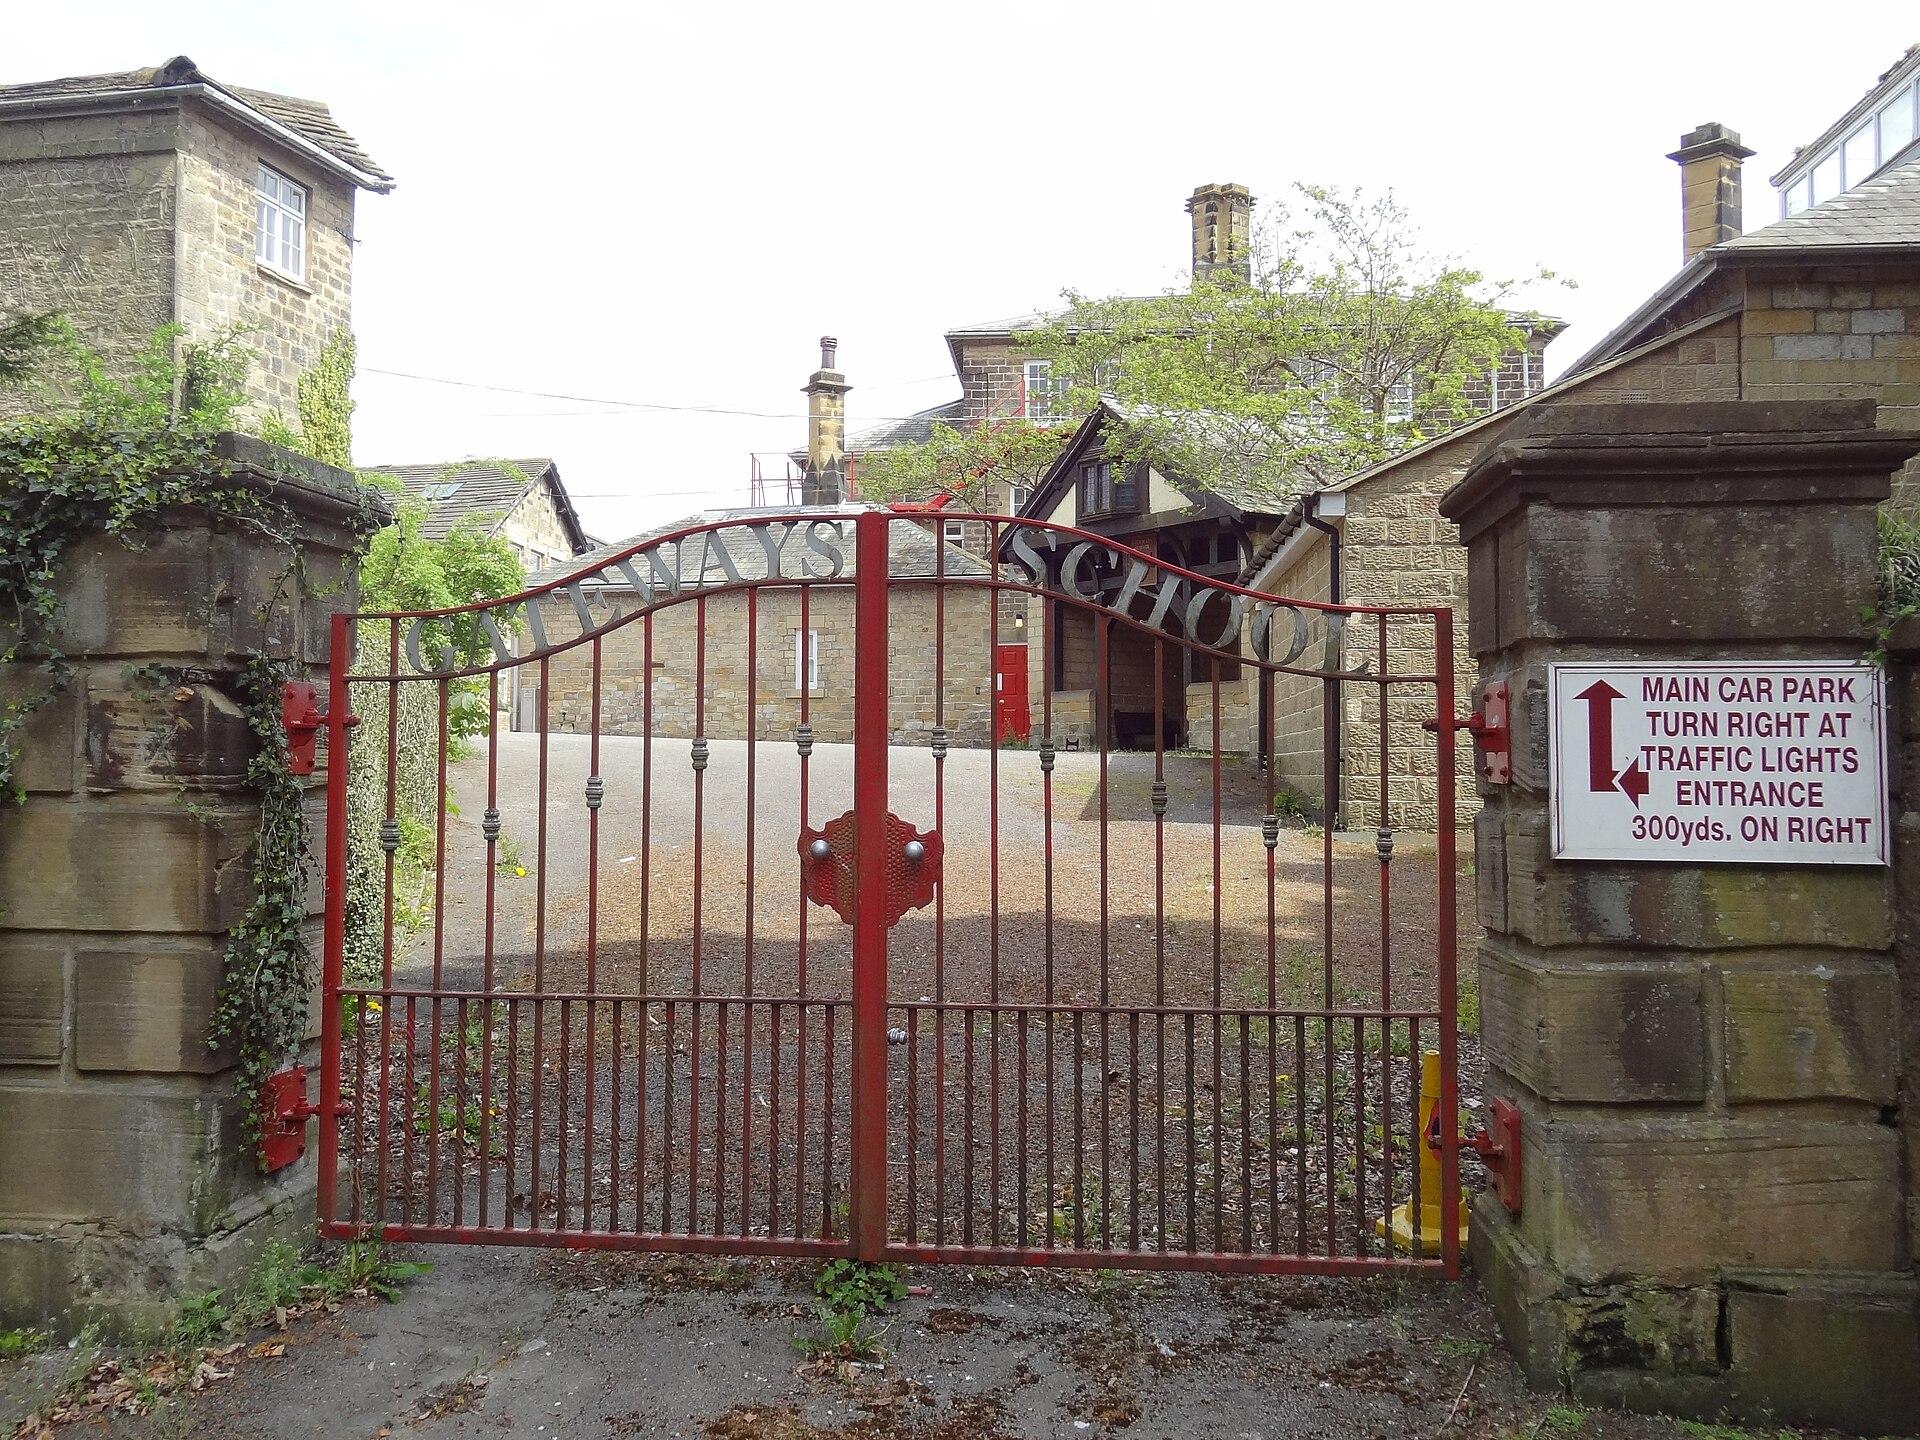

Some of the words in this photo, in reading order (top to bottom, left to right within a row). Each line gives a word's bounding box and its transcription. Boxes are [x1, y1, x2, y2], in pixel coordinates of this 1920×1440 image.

[405, 519, 844, 676] GATEWAYS
[1004, 527, 1370, 677] SCHOOL
[1642, 676, 1710, 703] MAIN
[1718, 677, 1773, 702] CAR
[1783, 677, 1856, 704] PARK
[1646, 711, 1718, 737] TURN
[1728, 712, 1810, 738] RIGHT
[1818, 713, 1852, 738] AT
[1640, 745, 1752, 772] TRAFFIC
[1761, 747, 1859, 774] LIGHTS
[1676, 780, 1825, 808] ENTRANCE
[1631, 814, 1732, 847] 300yds.
[1740, 816, 1779, 842] ON
[1788, 817, 1872, 844] RIGHT
